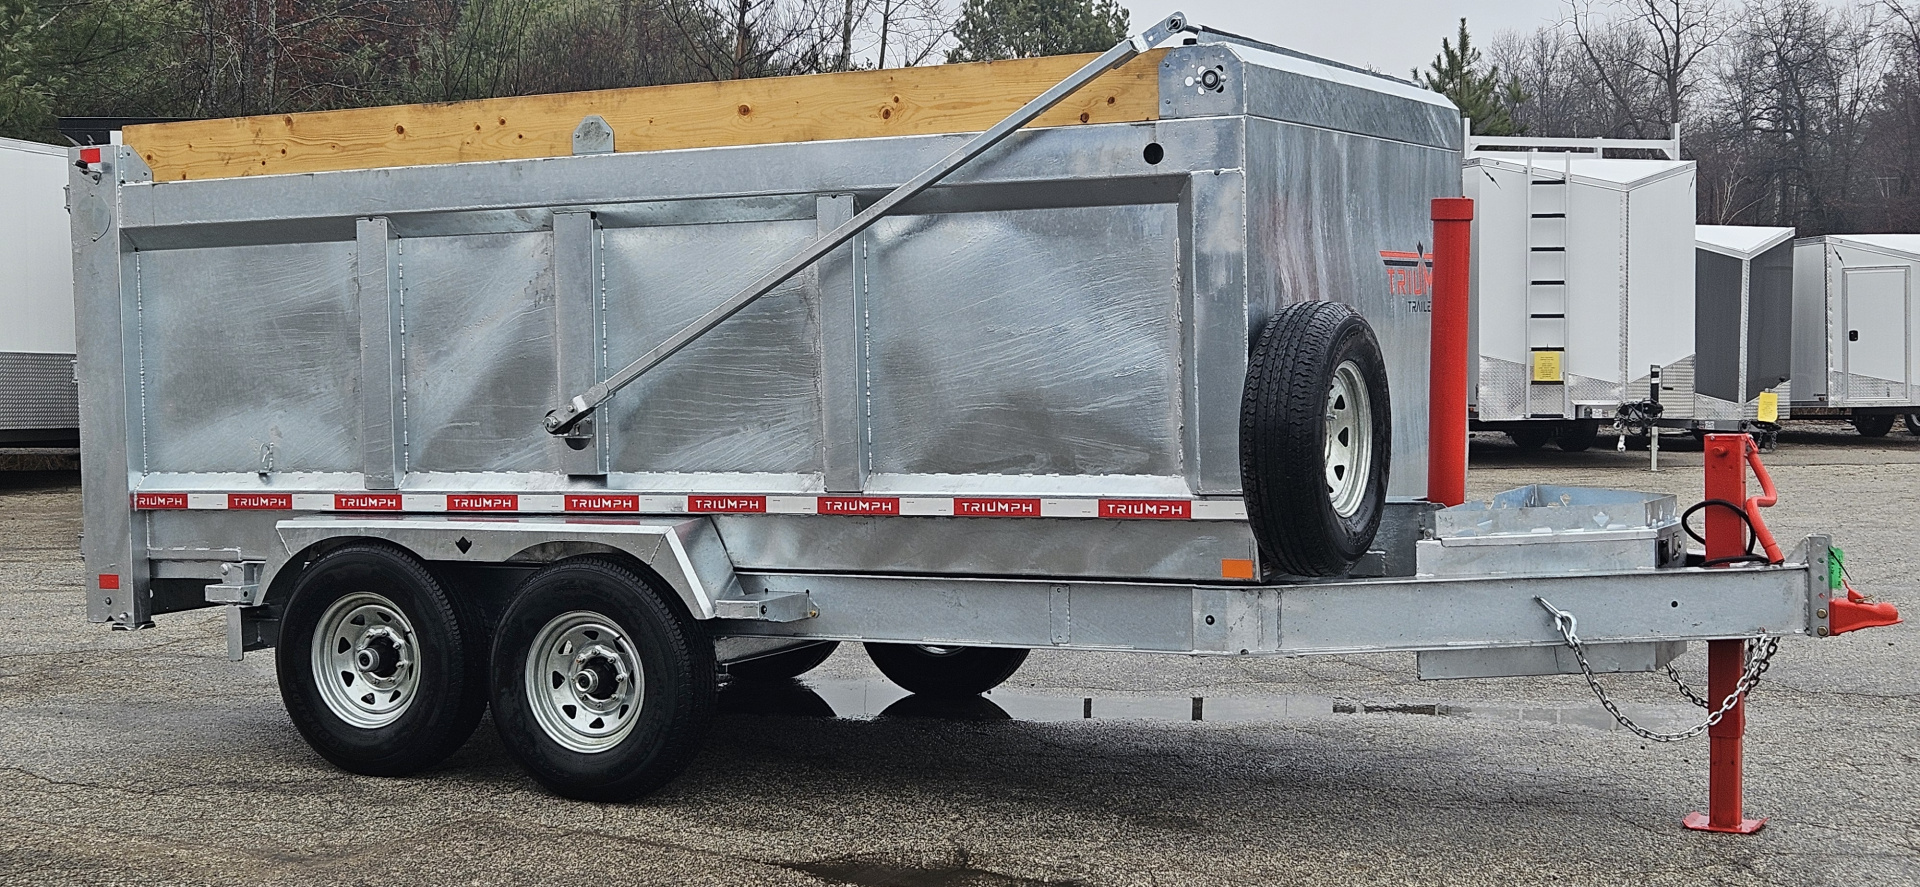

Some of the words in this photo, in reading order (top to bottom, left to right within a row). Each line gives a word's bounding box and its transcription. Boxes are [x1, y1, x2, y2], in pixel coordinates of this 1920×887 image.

[1386, 264, 1433, 295] TRIUM
[1408, 300, 1431, 312] TRAILE
[137, 496, 182, 507] RIUMPH
[233, 497, 286, 507] TRIUMPH
[340, 497, 396, 507] TRIUMPH
[453, 498, 512, 508] TRIUMPH
[571, 497, 632, 508] TRIUMPH
[695, 499, 759, 509] TRIUMPH
[825, 500, 892, 511] TRIUMPH
[962, 501, 1033, 513] TRIUMPH
[1107, 502, 1183, 515] TRIUMPH
